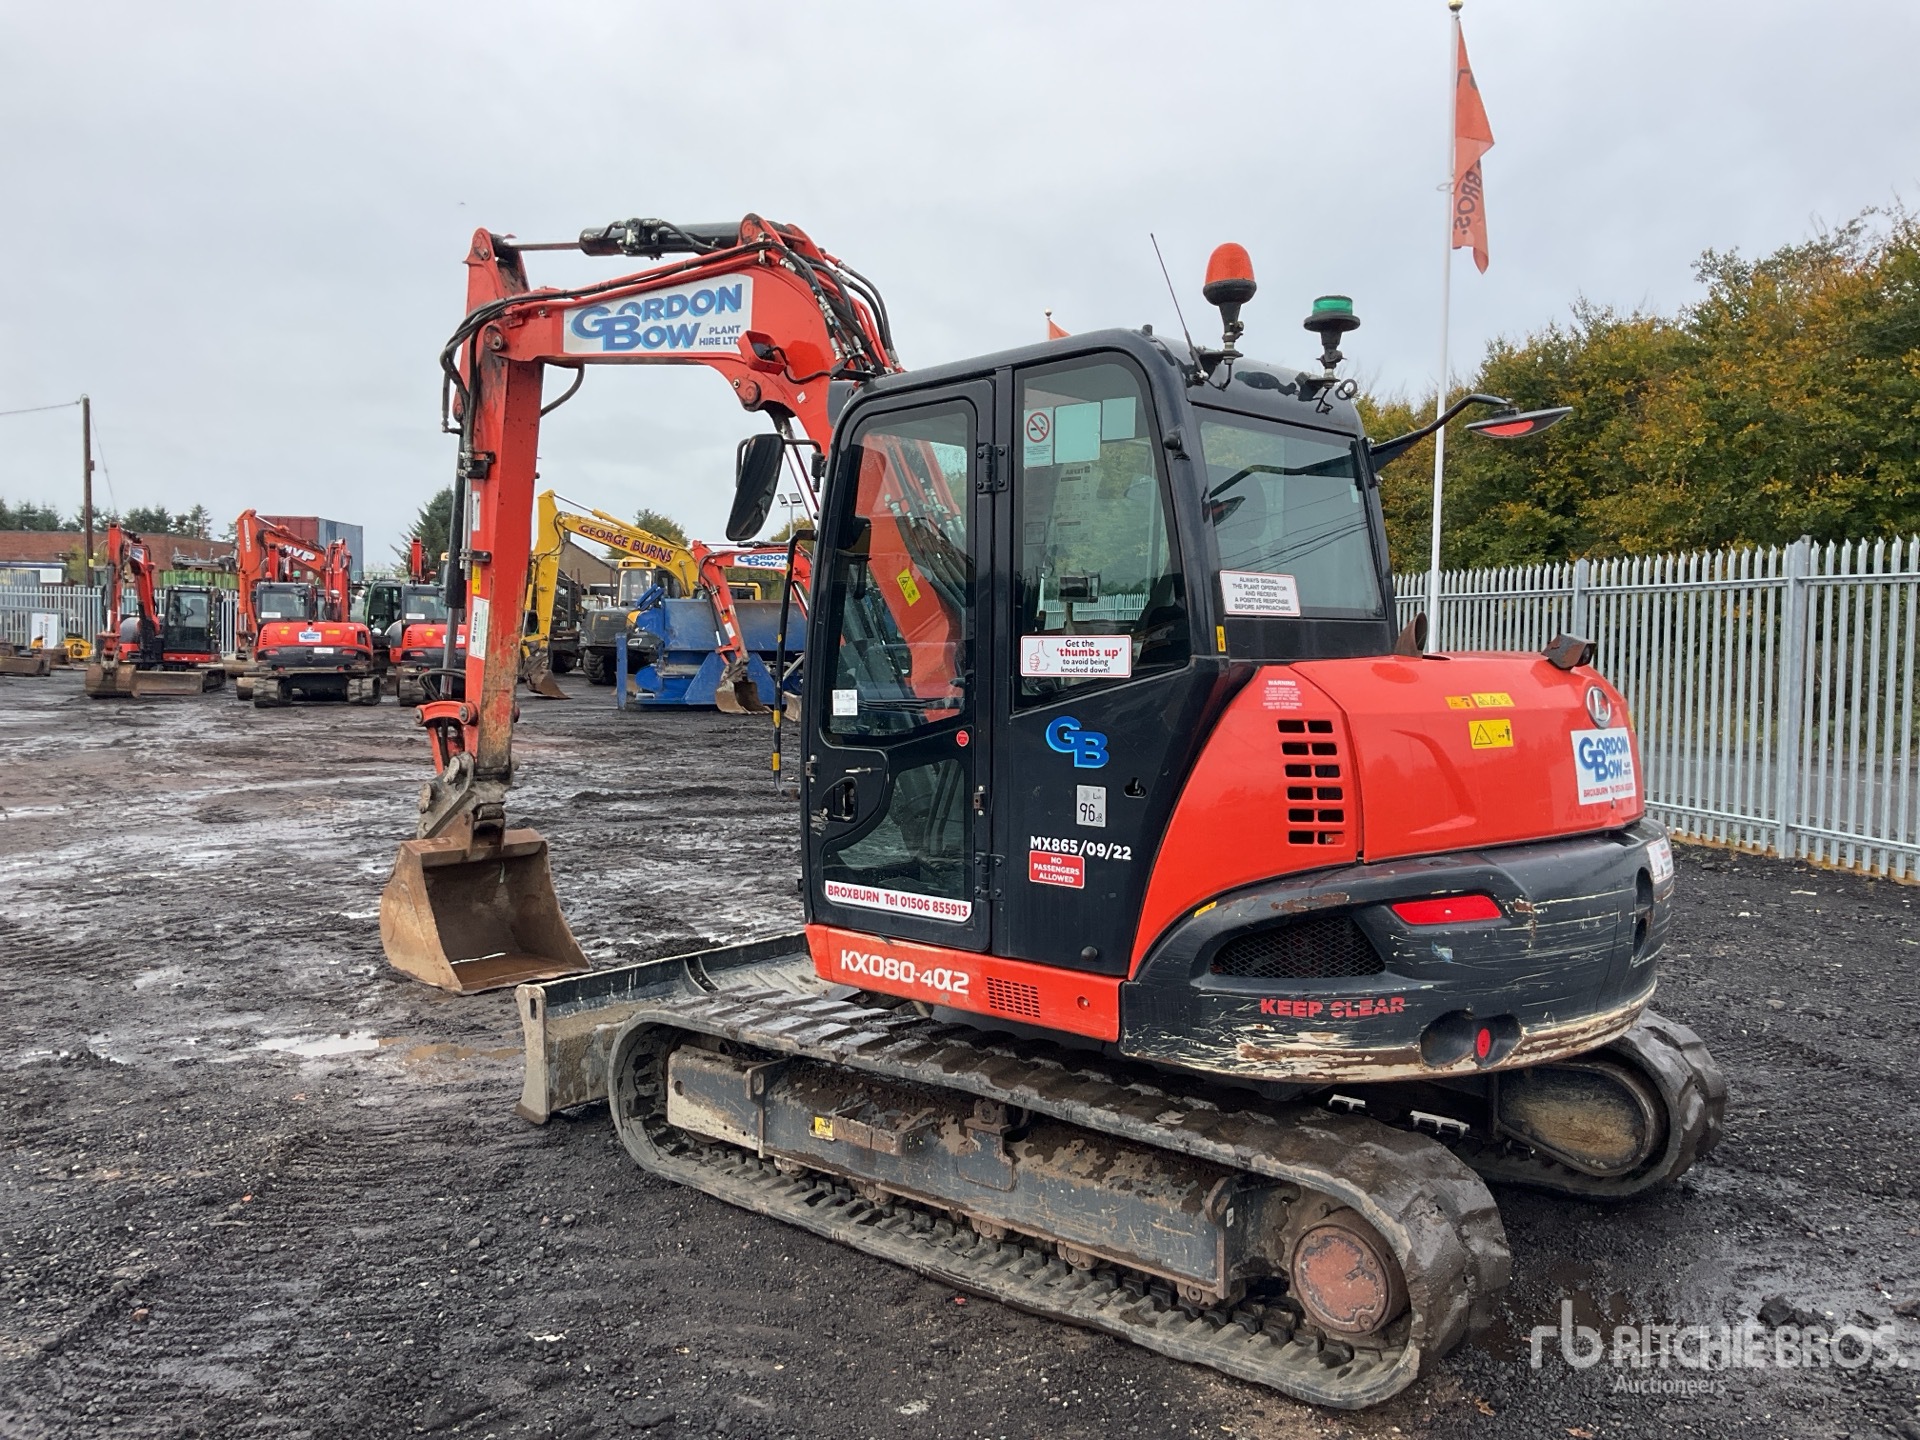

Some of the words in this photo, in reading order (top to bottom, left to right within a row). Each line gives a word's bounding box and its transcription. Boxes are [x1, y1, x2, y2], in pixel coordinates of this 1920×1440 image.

[571, 283, 743, 340] GORDON
[593, 314, 702, 352] BOW
[709, 325, 741, 335] PLANT
[699, 336, 721, 346] HIRE
[579, 524, 628, 548] GEORGE
[630, 539, 674, 563] BURNS
[737, 554, 788, 563] GORDON
[745, 557, 777, 566] BOW
[1065, 639, 1079, 647] Get
[1082, 640, 1095, 648] the
[1046, 716, 1109, 769] GB
[1579, 736, 1629, 770] GORDON
[1588, 749, 1622, 782] BOW
[1080, 803, 1095, 821] 96
[1030, 835, 1132, 860] MX865/09/22
[1033, 863, 1080, 875] PASSENGERS
[1050, 857, 1062, 865] NO
[1039, 873, 1075, 883] ALLOWED
[828, 885, 880, 903] BROXBURN
[884, 893, 898, 906] Tel
[900, 896, 930, 911] 01506
[932, 902, 968, 917] 855913
[1260, 998, 1324, 1018] KEEP
[1330, 997, 1405, 1018] CLEAR
